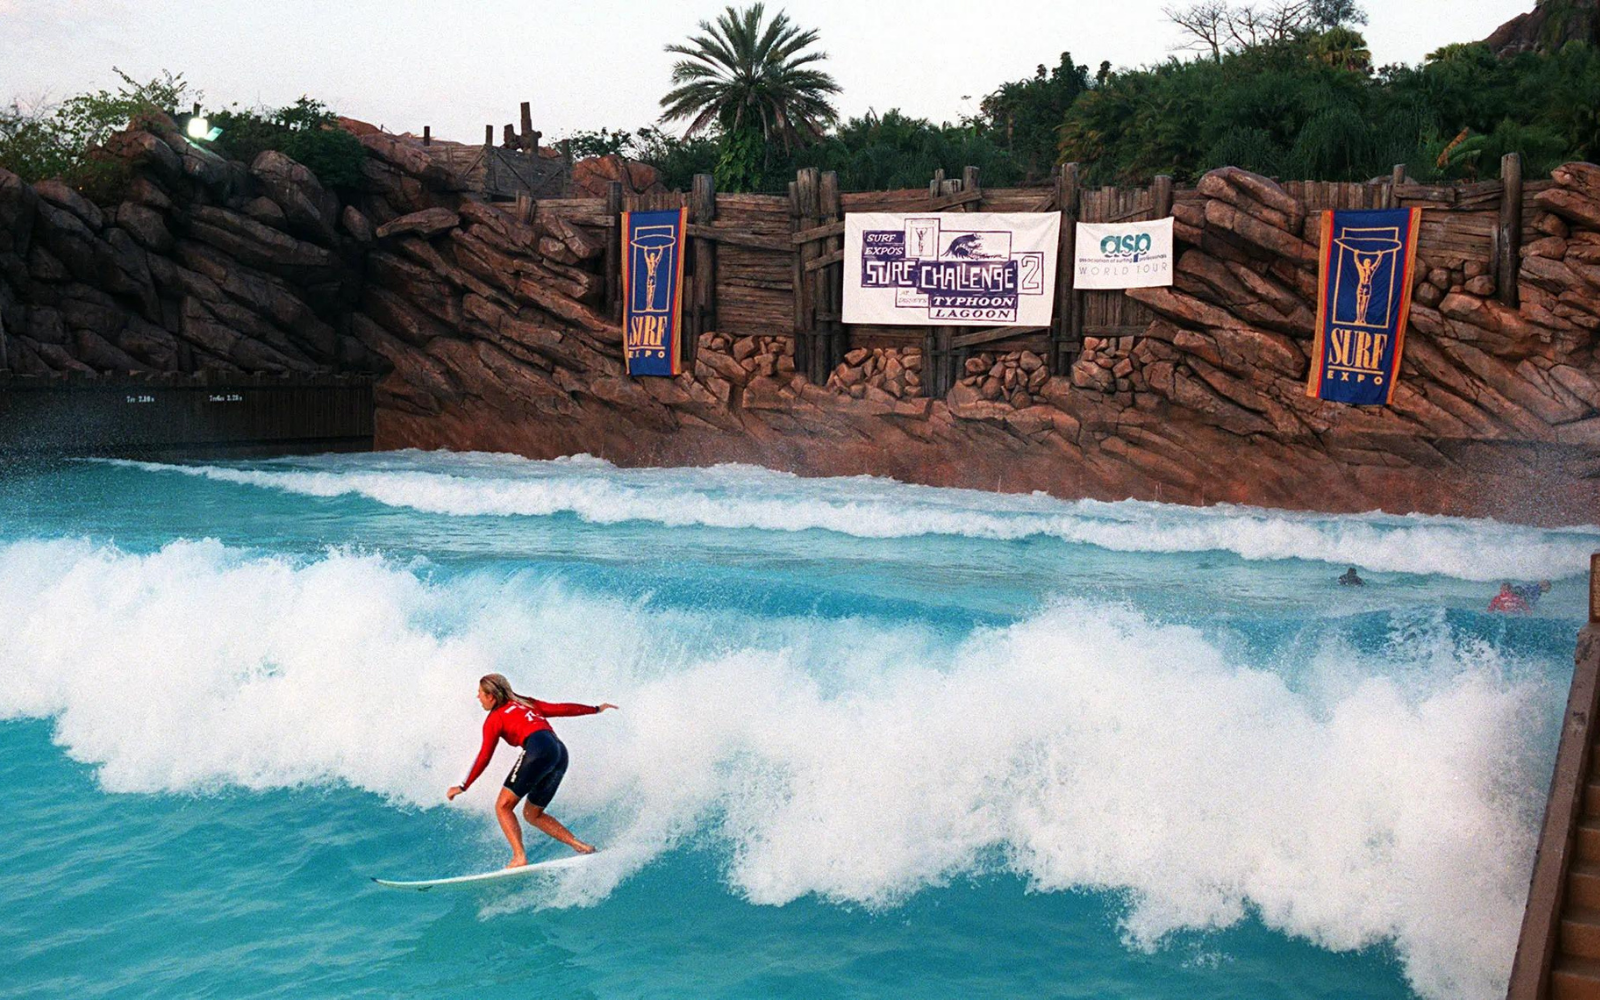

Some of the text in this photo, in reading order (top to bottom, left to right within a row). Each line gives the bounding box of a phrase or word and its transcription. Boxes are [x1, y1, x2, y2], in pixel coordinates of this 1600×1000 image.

[866, 233, 896, 243] SURF
[864, 246, 904, 256] EXPO'S
[1100, 233, 1151, 263] asp
[866, 256, 1041, 292] SURF CHALLENGE 2
[1079, 262, 1168, 276] WORLD TOUR
[933, 295, 1016, 307] TYPHOON
[935, 308, 1011, 319] LAGOON
[1328, 327, 1388, 370] SURF
[1327, 370, 1383, 385] EXPO
